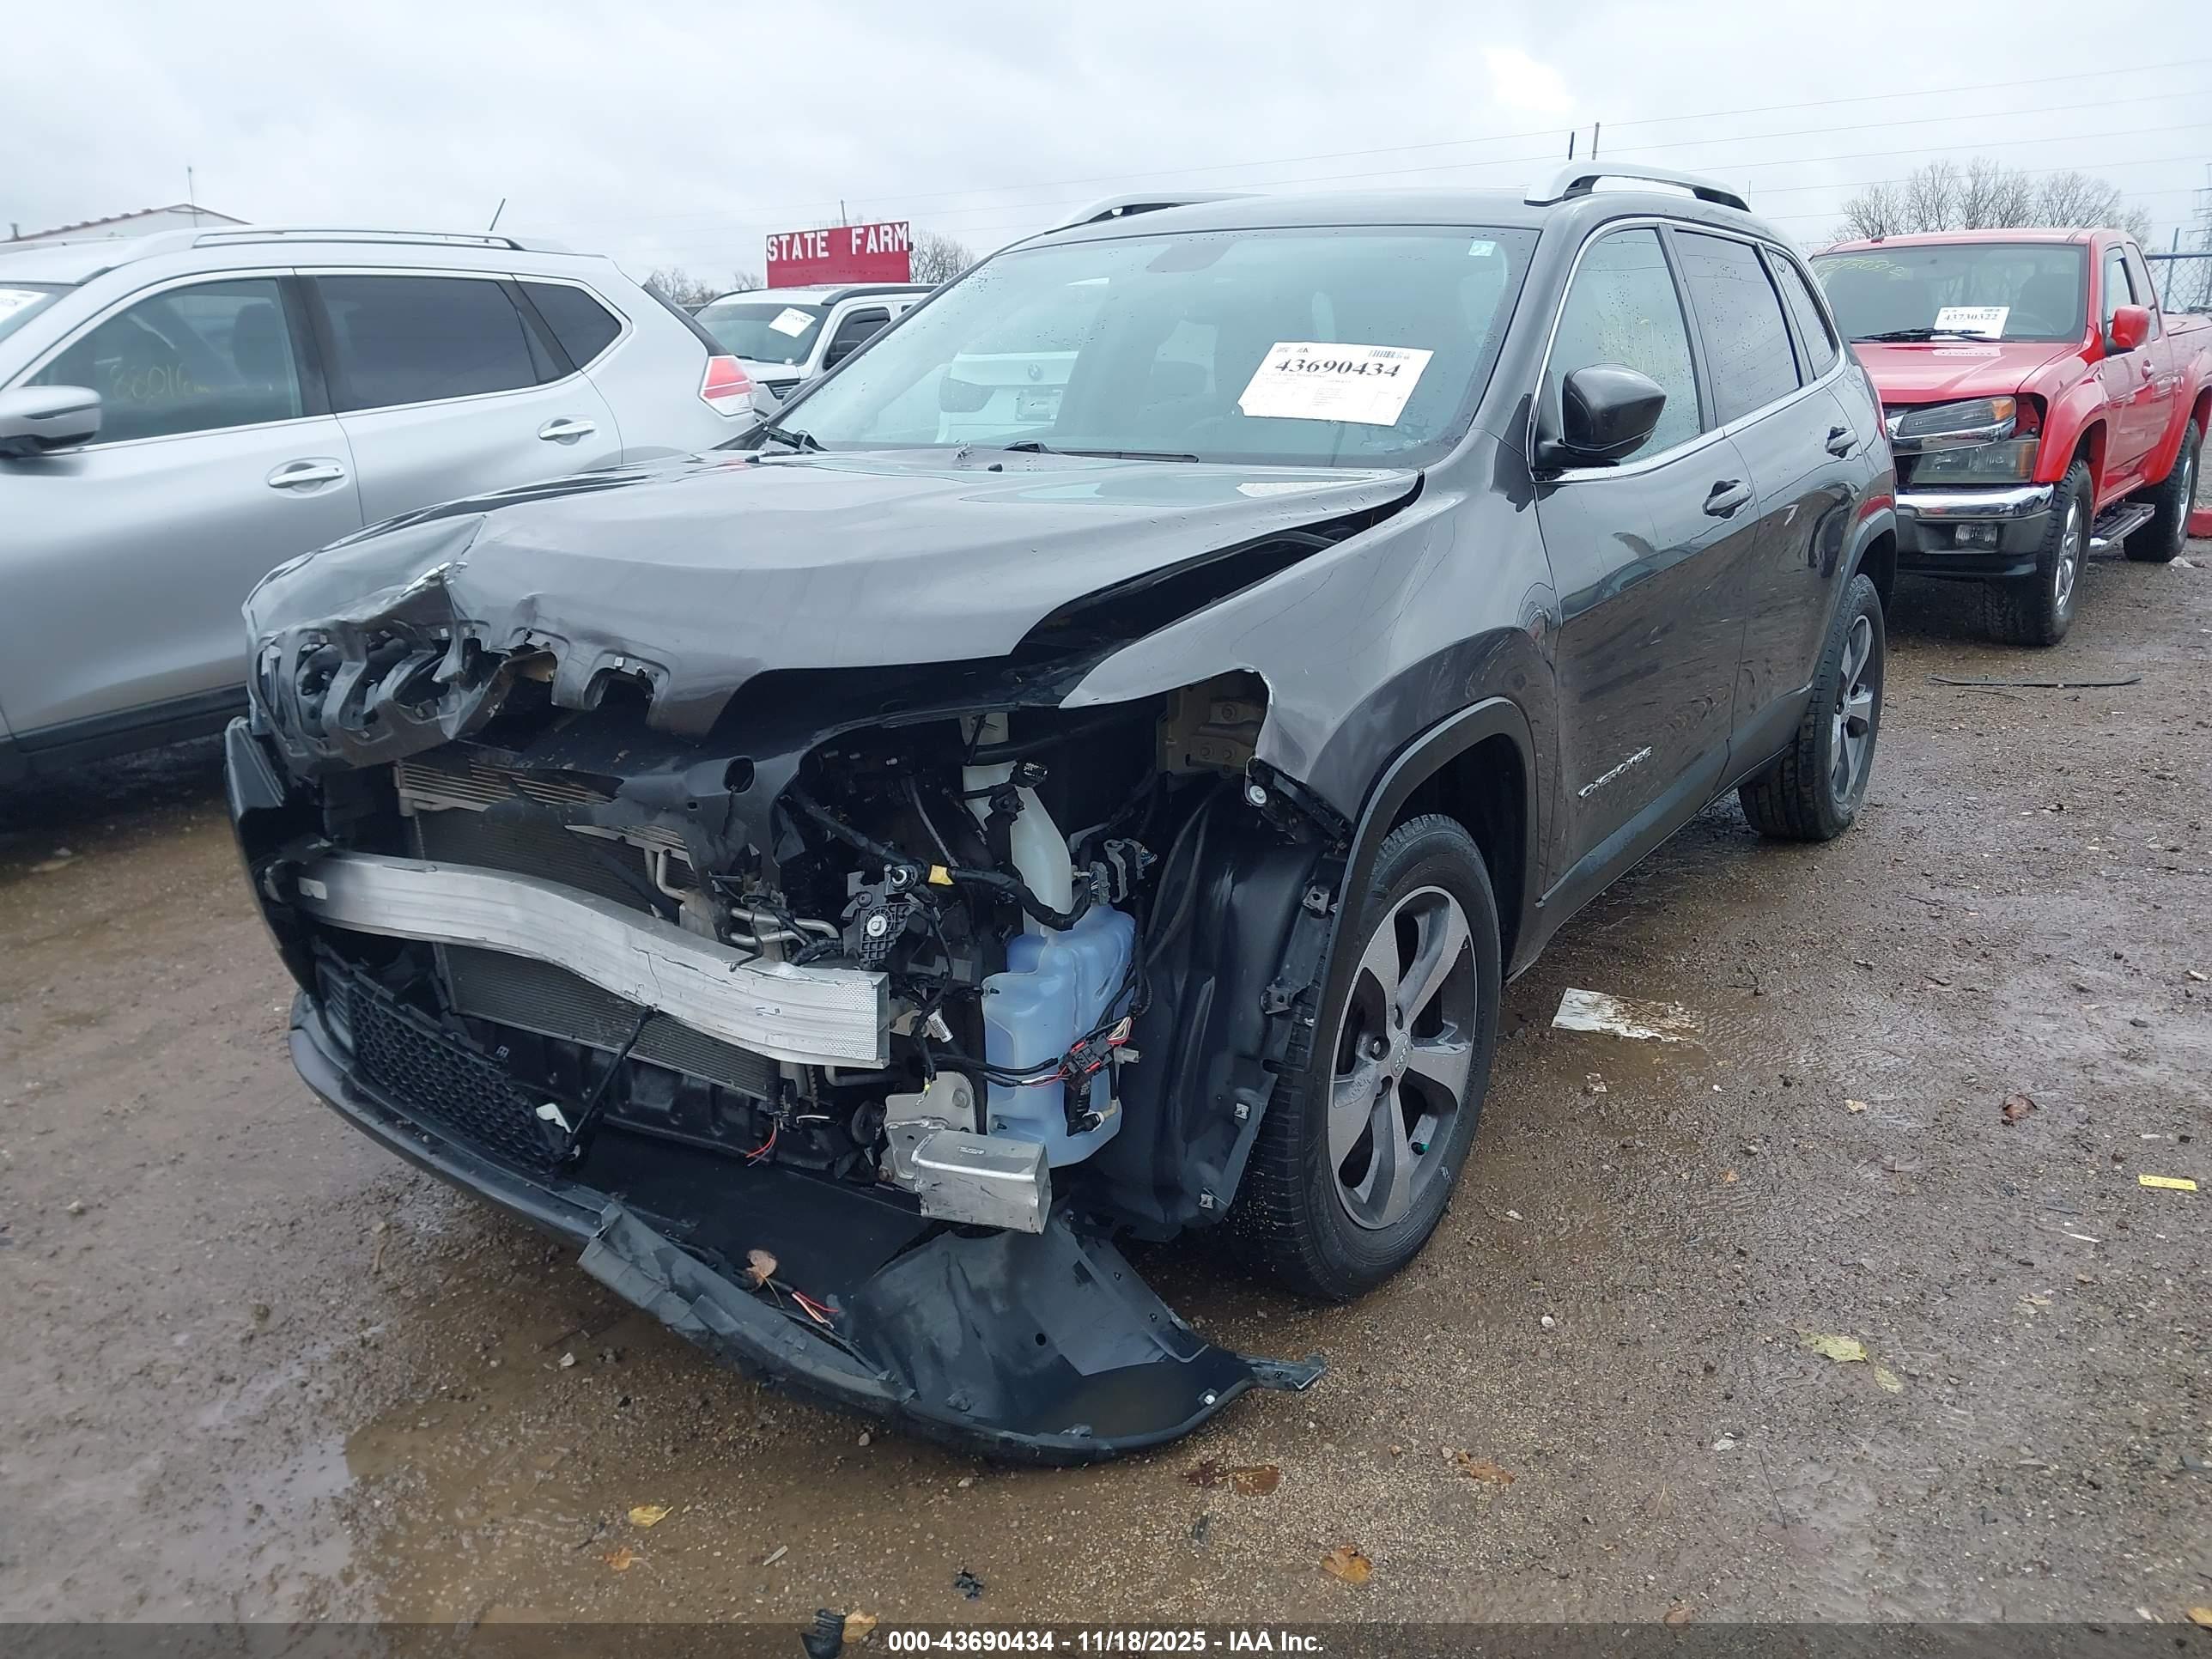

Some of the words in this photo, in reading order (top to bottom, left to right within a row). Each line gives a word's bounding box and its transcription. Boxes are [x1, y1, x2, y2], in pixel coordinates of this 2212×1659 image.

[767, 231, 830, 261] STATE
[851, 222, 908, 255] FARM
[1274, 357, 1401, 378] 43690434
[1577, 745, 1653, 799] CHEROKEE
